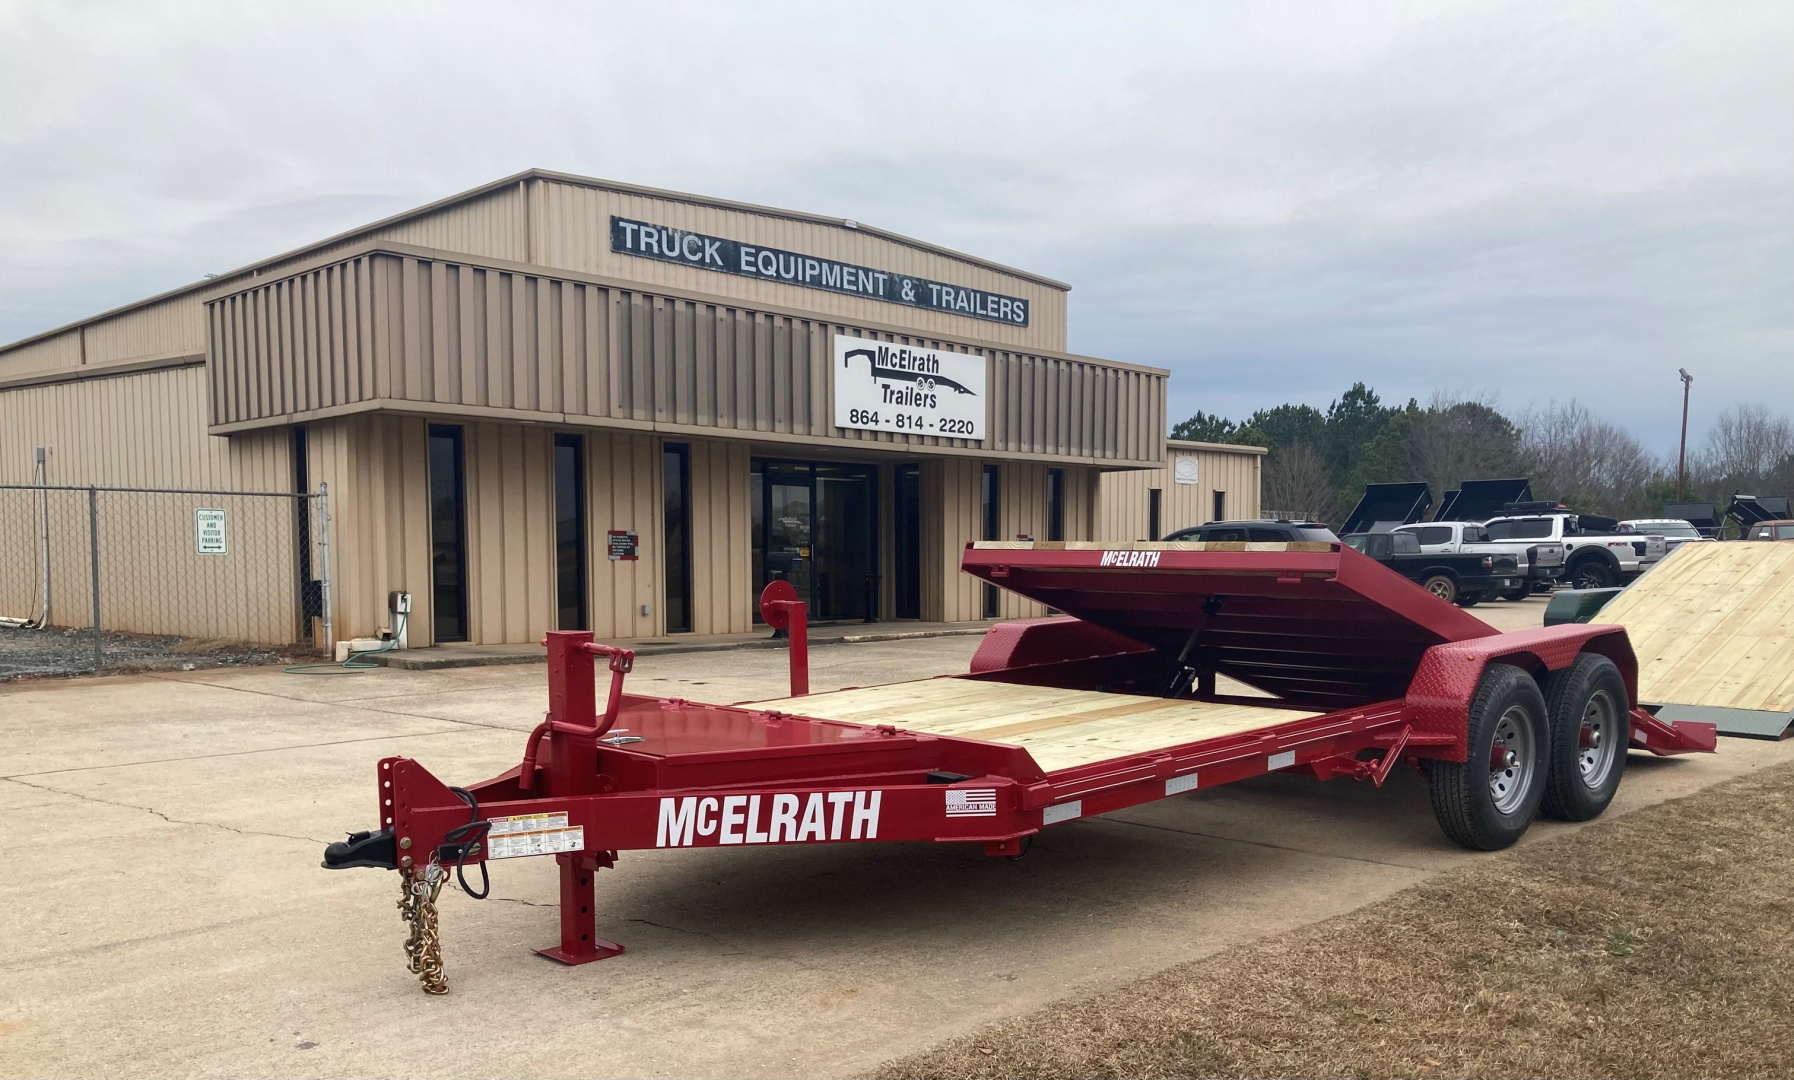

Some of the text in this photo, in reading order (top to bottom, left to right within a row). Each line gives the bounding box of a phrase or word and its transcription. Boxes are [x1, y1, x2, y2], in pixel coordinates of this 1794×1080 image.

[618, 221, 1025, 323] TRUCK EQUIPMENT & TRAILERS
[877, 345, 940, 374] McElrath
[881, 383, 937, 409] Trailers
[850, 408, 880, 426] 864
[896, 413, 924, 430] 814
[939, 418, 974, 435] 2220
[946, 802, 996, 811] AMERICAN MADE
